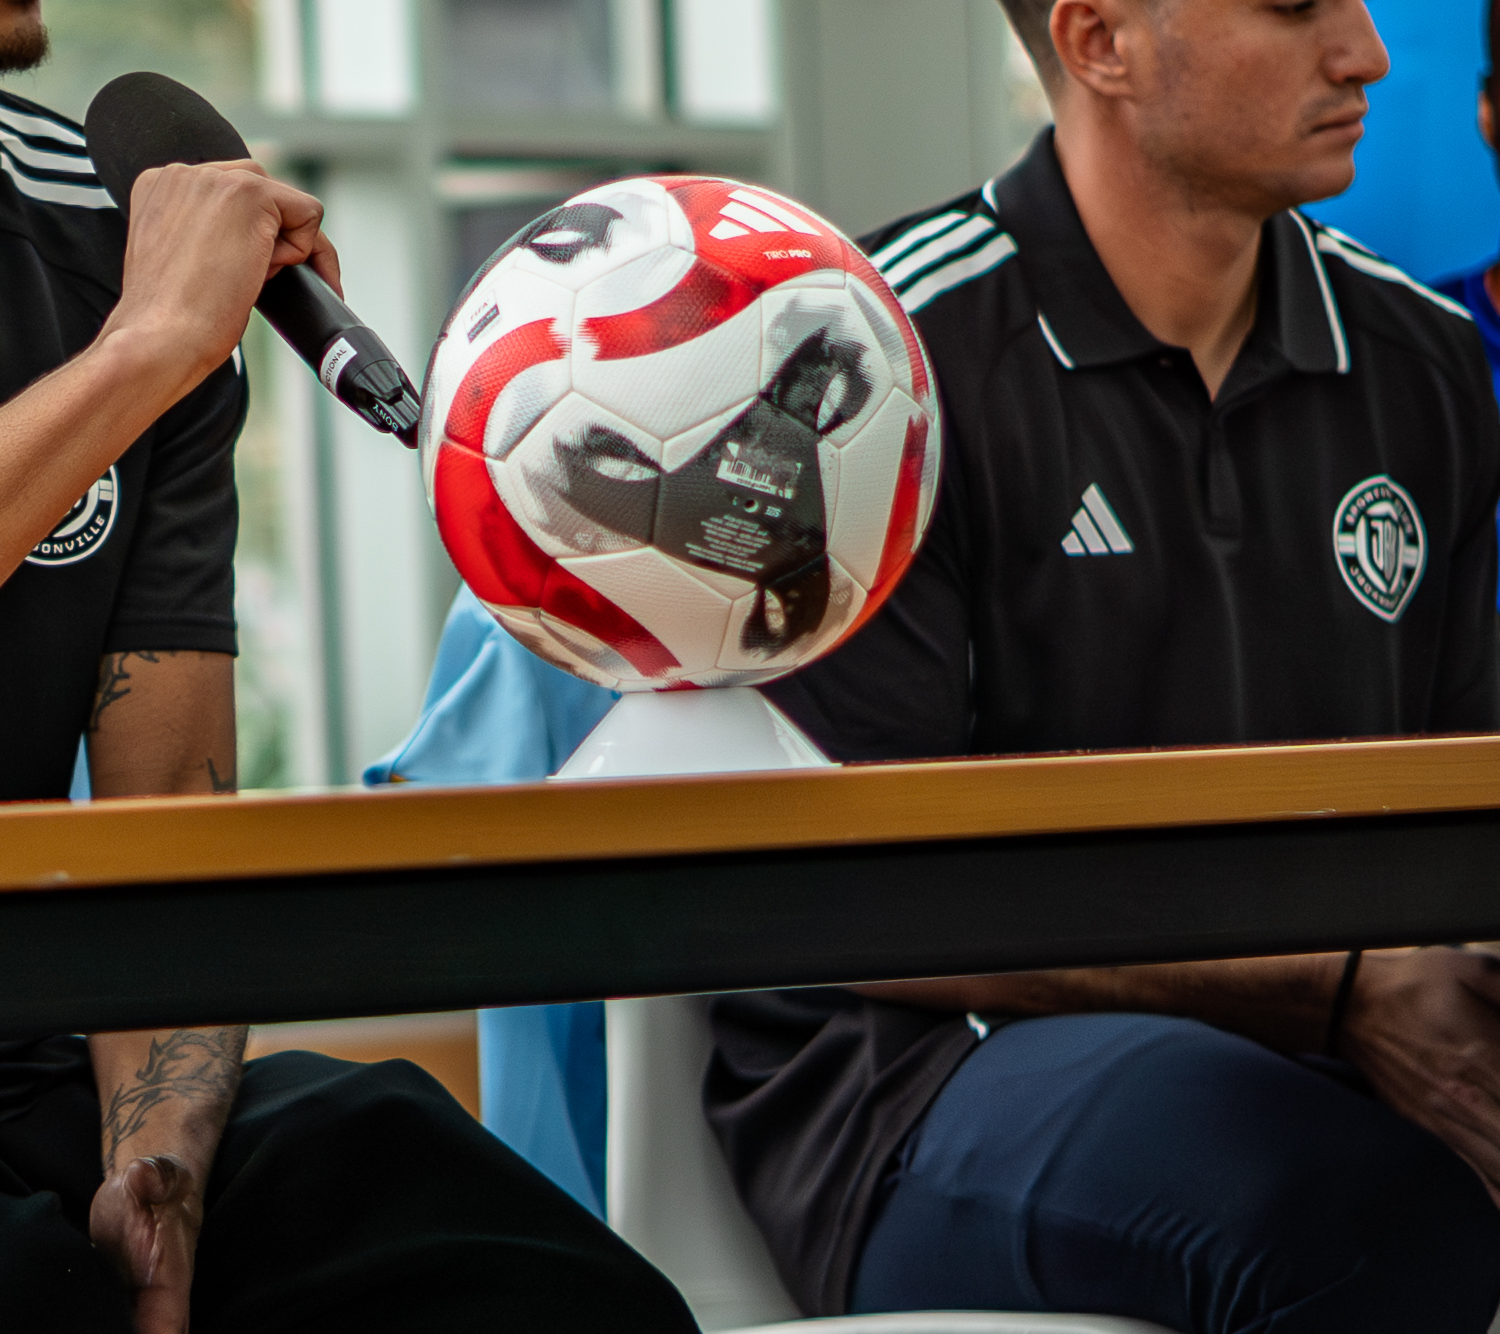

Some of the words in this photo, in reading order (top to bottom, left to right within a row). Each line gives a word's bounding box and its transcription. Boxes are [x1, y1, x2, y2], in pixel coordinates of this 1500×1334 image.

[763, 250, 788, 260] TIRO
[789, 249, 811, 259] PRO
[33, 515, 105, 554] ONVILLE
